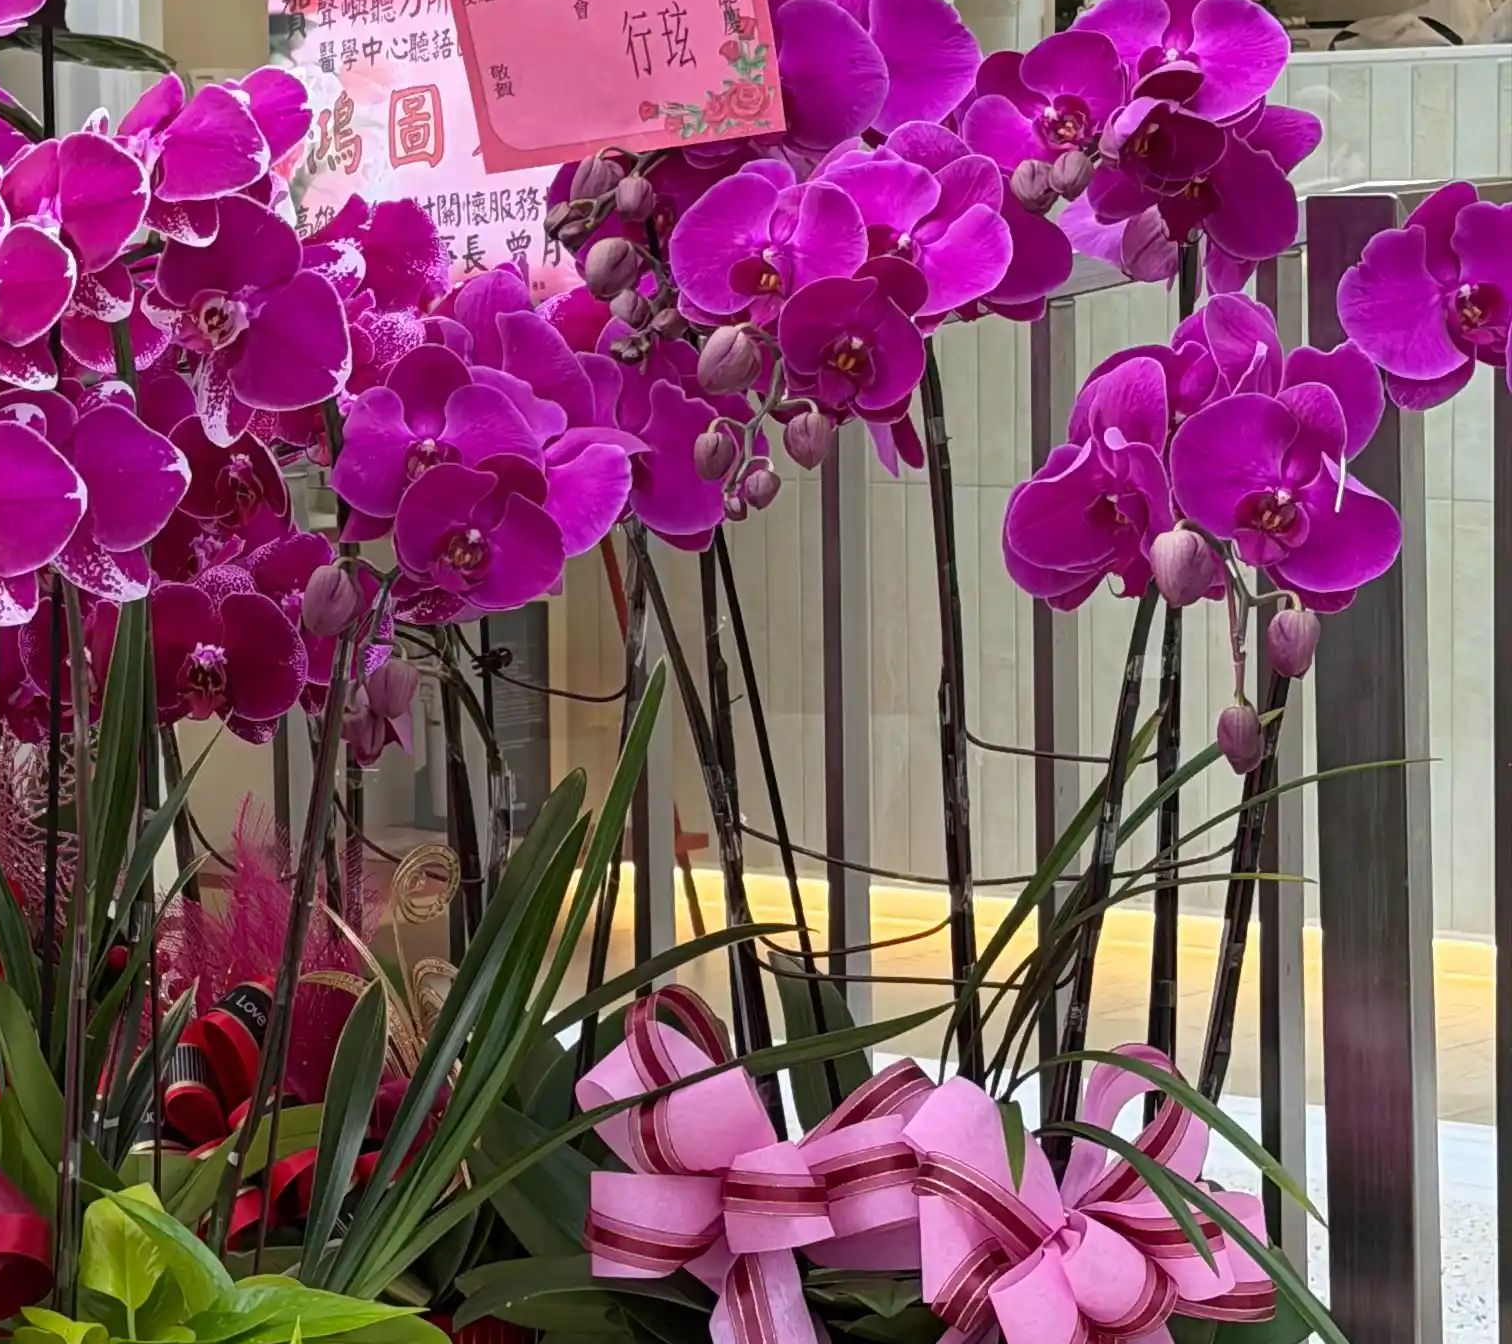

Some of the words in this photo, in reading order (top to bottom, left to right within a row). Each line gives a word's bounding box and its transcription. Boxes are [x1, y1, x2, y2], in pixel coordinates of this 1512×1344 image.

[318, 28, 463, 74] 醫學中心聽語
[307, 84, 481, 175] 鴻圖
[235, 994, 268, 1027] Love
